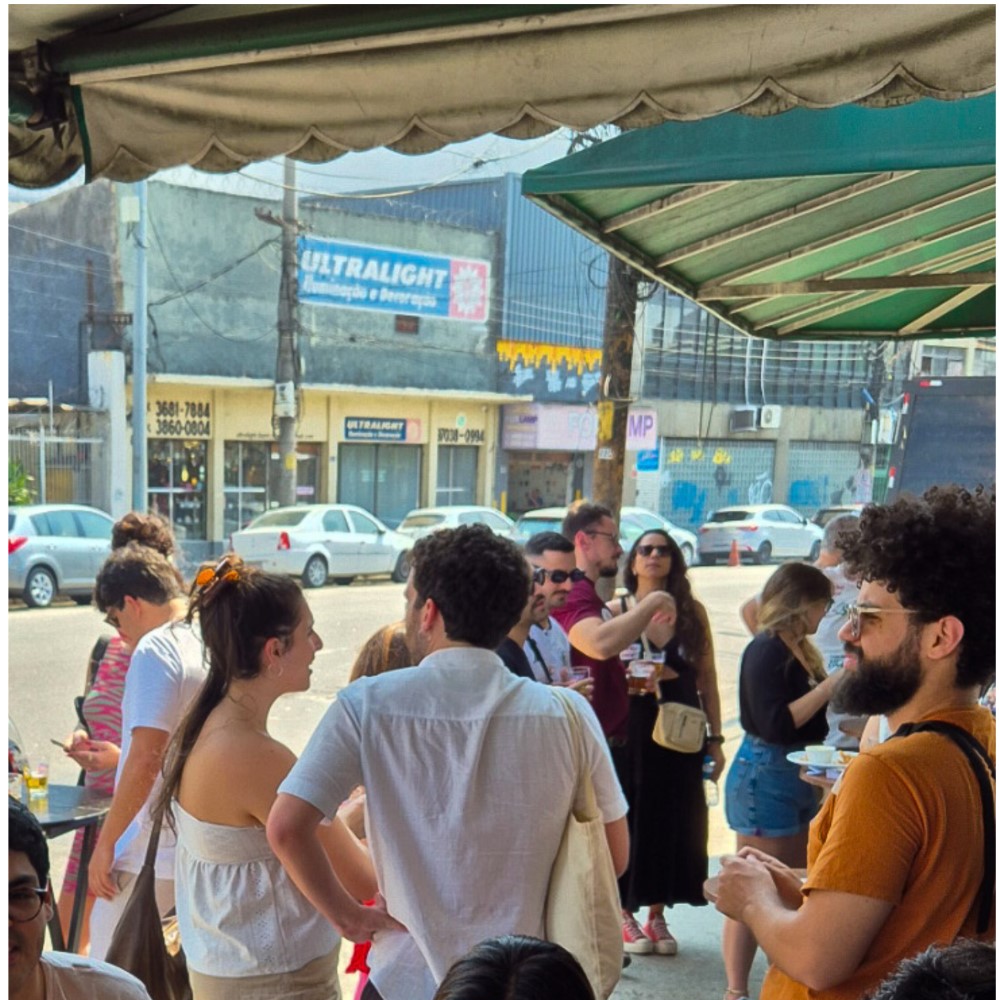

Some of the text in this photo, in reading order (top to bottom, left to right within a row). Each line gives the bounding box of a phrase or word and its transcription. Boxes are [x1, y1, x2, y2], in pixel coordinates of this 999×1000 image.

[301, 250, 449, 290] ULTRALIGHT
[346, 419, 405, 431] ULTRALIGHT
[628, 415, 654, 439] MP
